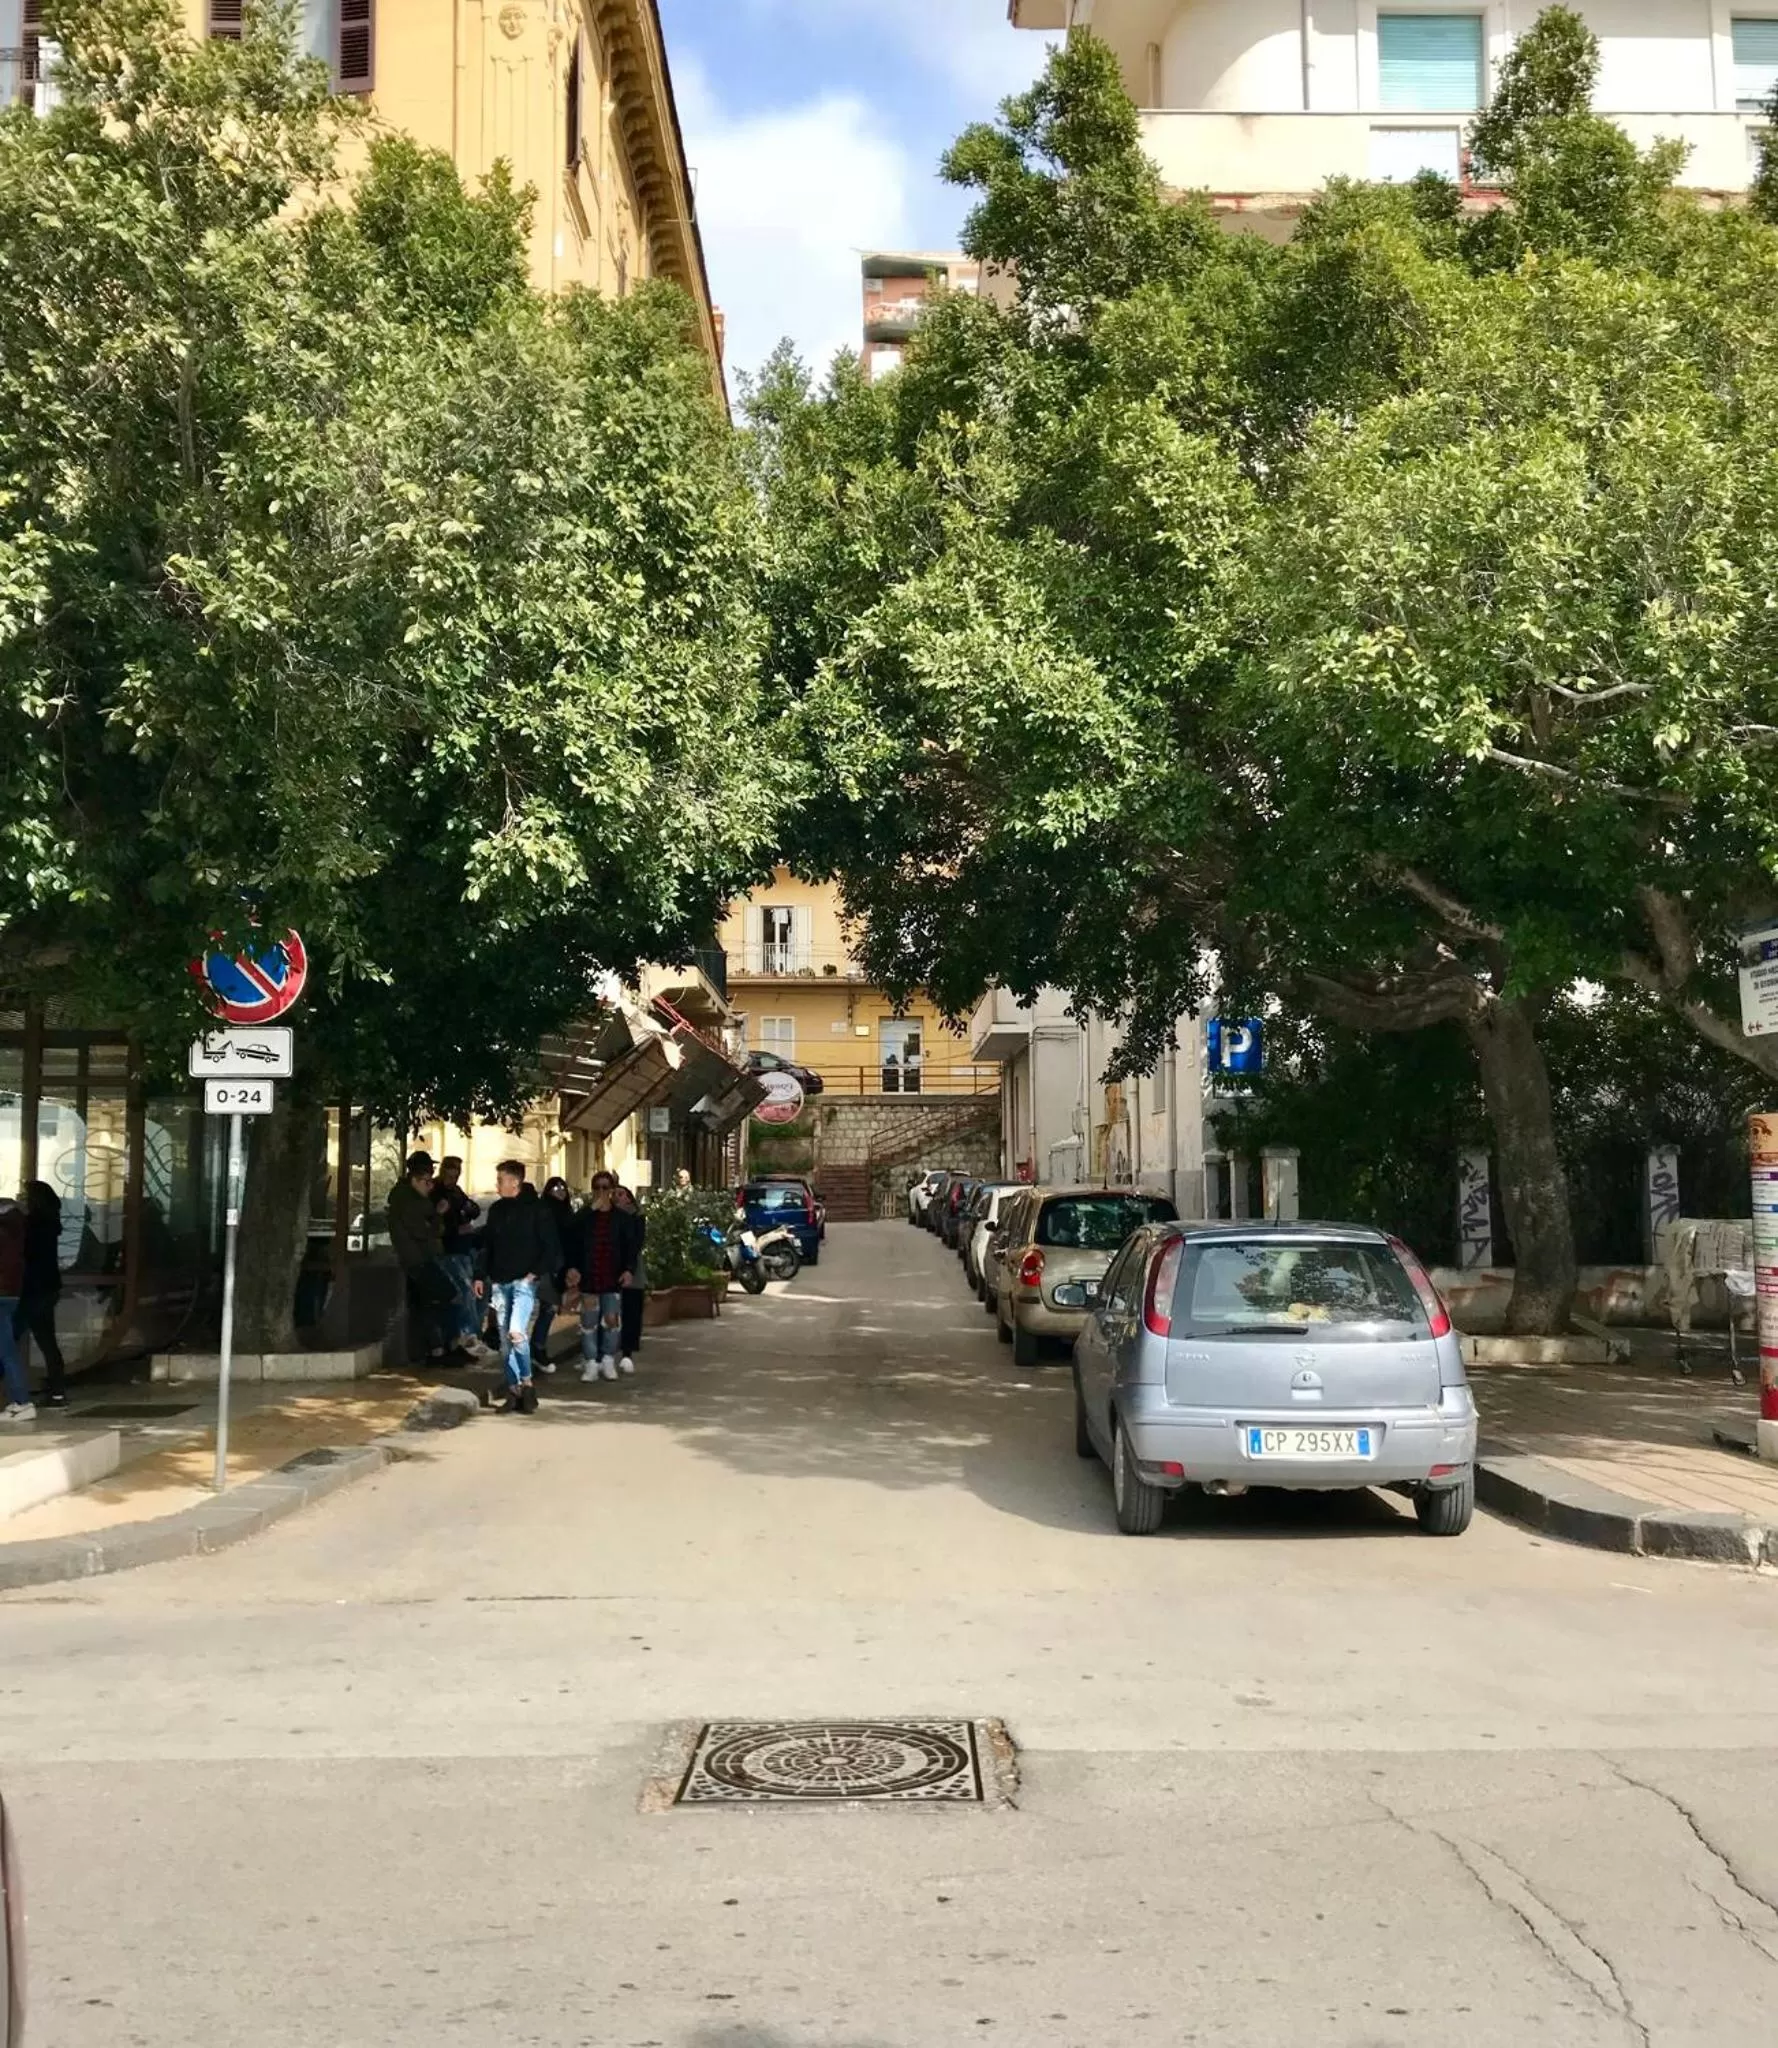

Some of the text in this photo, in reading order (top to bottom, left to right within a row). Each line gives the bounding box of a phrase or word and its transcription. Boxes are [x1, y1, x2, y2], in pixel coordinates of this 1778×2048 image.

[1220, 1025, 1252, 1068] P
[216, 1089, 262, 1104] 0-24
[1264, 1431, 1287, 1452] CP
[1295, 1432, 1356, 1453] 295XX
